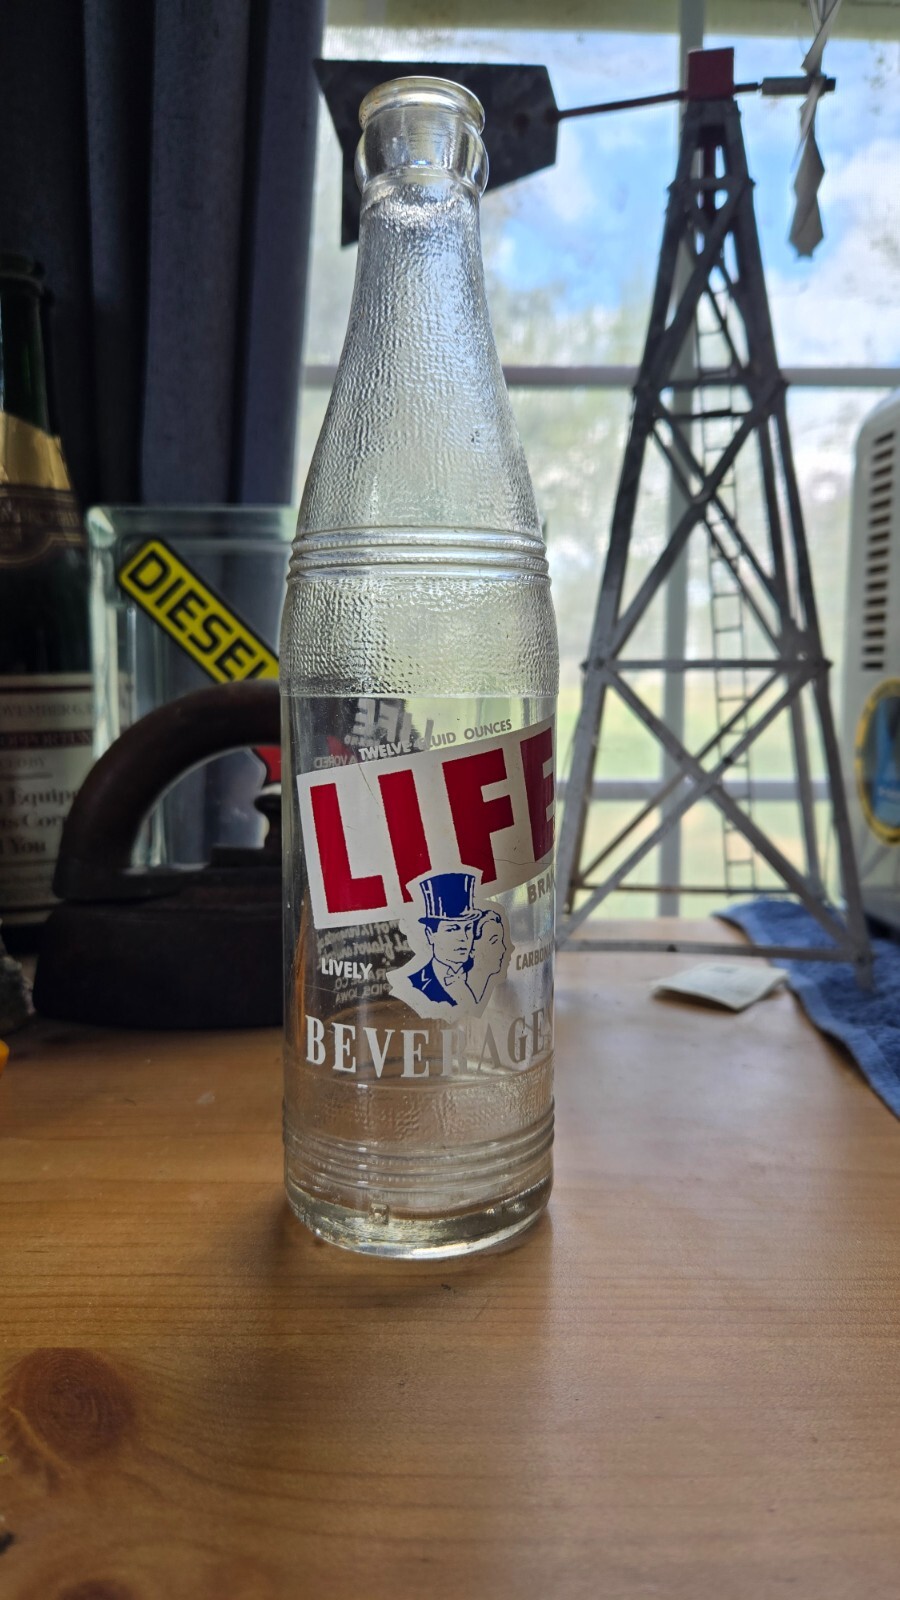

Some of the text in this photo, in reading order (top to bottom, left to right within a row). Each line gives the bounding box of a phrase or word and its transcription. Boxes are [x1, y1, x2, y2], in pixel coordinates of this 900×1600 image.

[358, 742, 412, 761] TWELVE
[464, 719, 512, 740] OUNCES
[9, 787, 76, 806] Equip
[310, 727, 554, 914] LIFE
[321, 957, 373, 980] LIVELY
[304, 1008, 551, 1078] BEVERAGE
